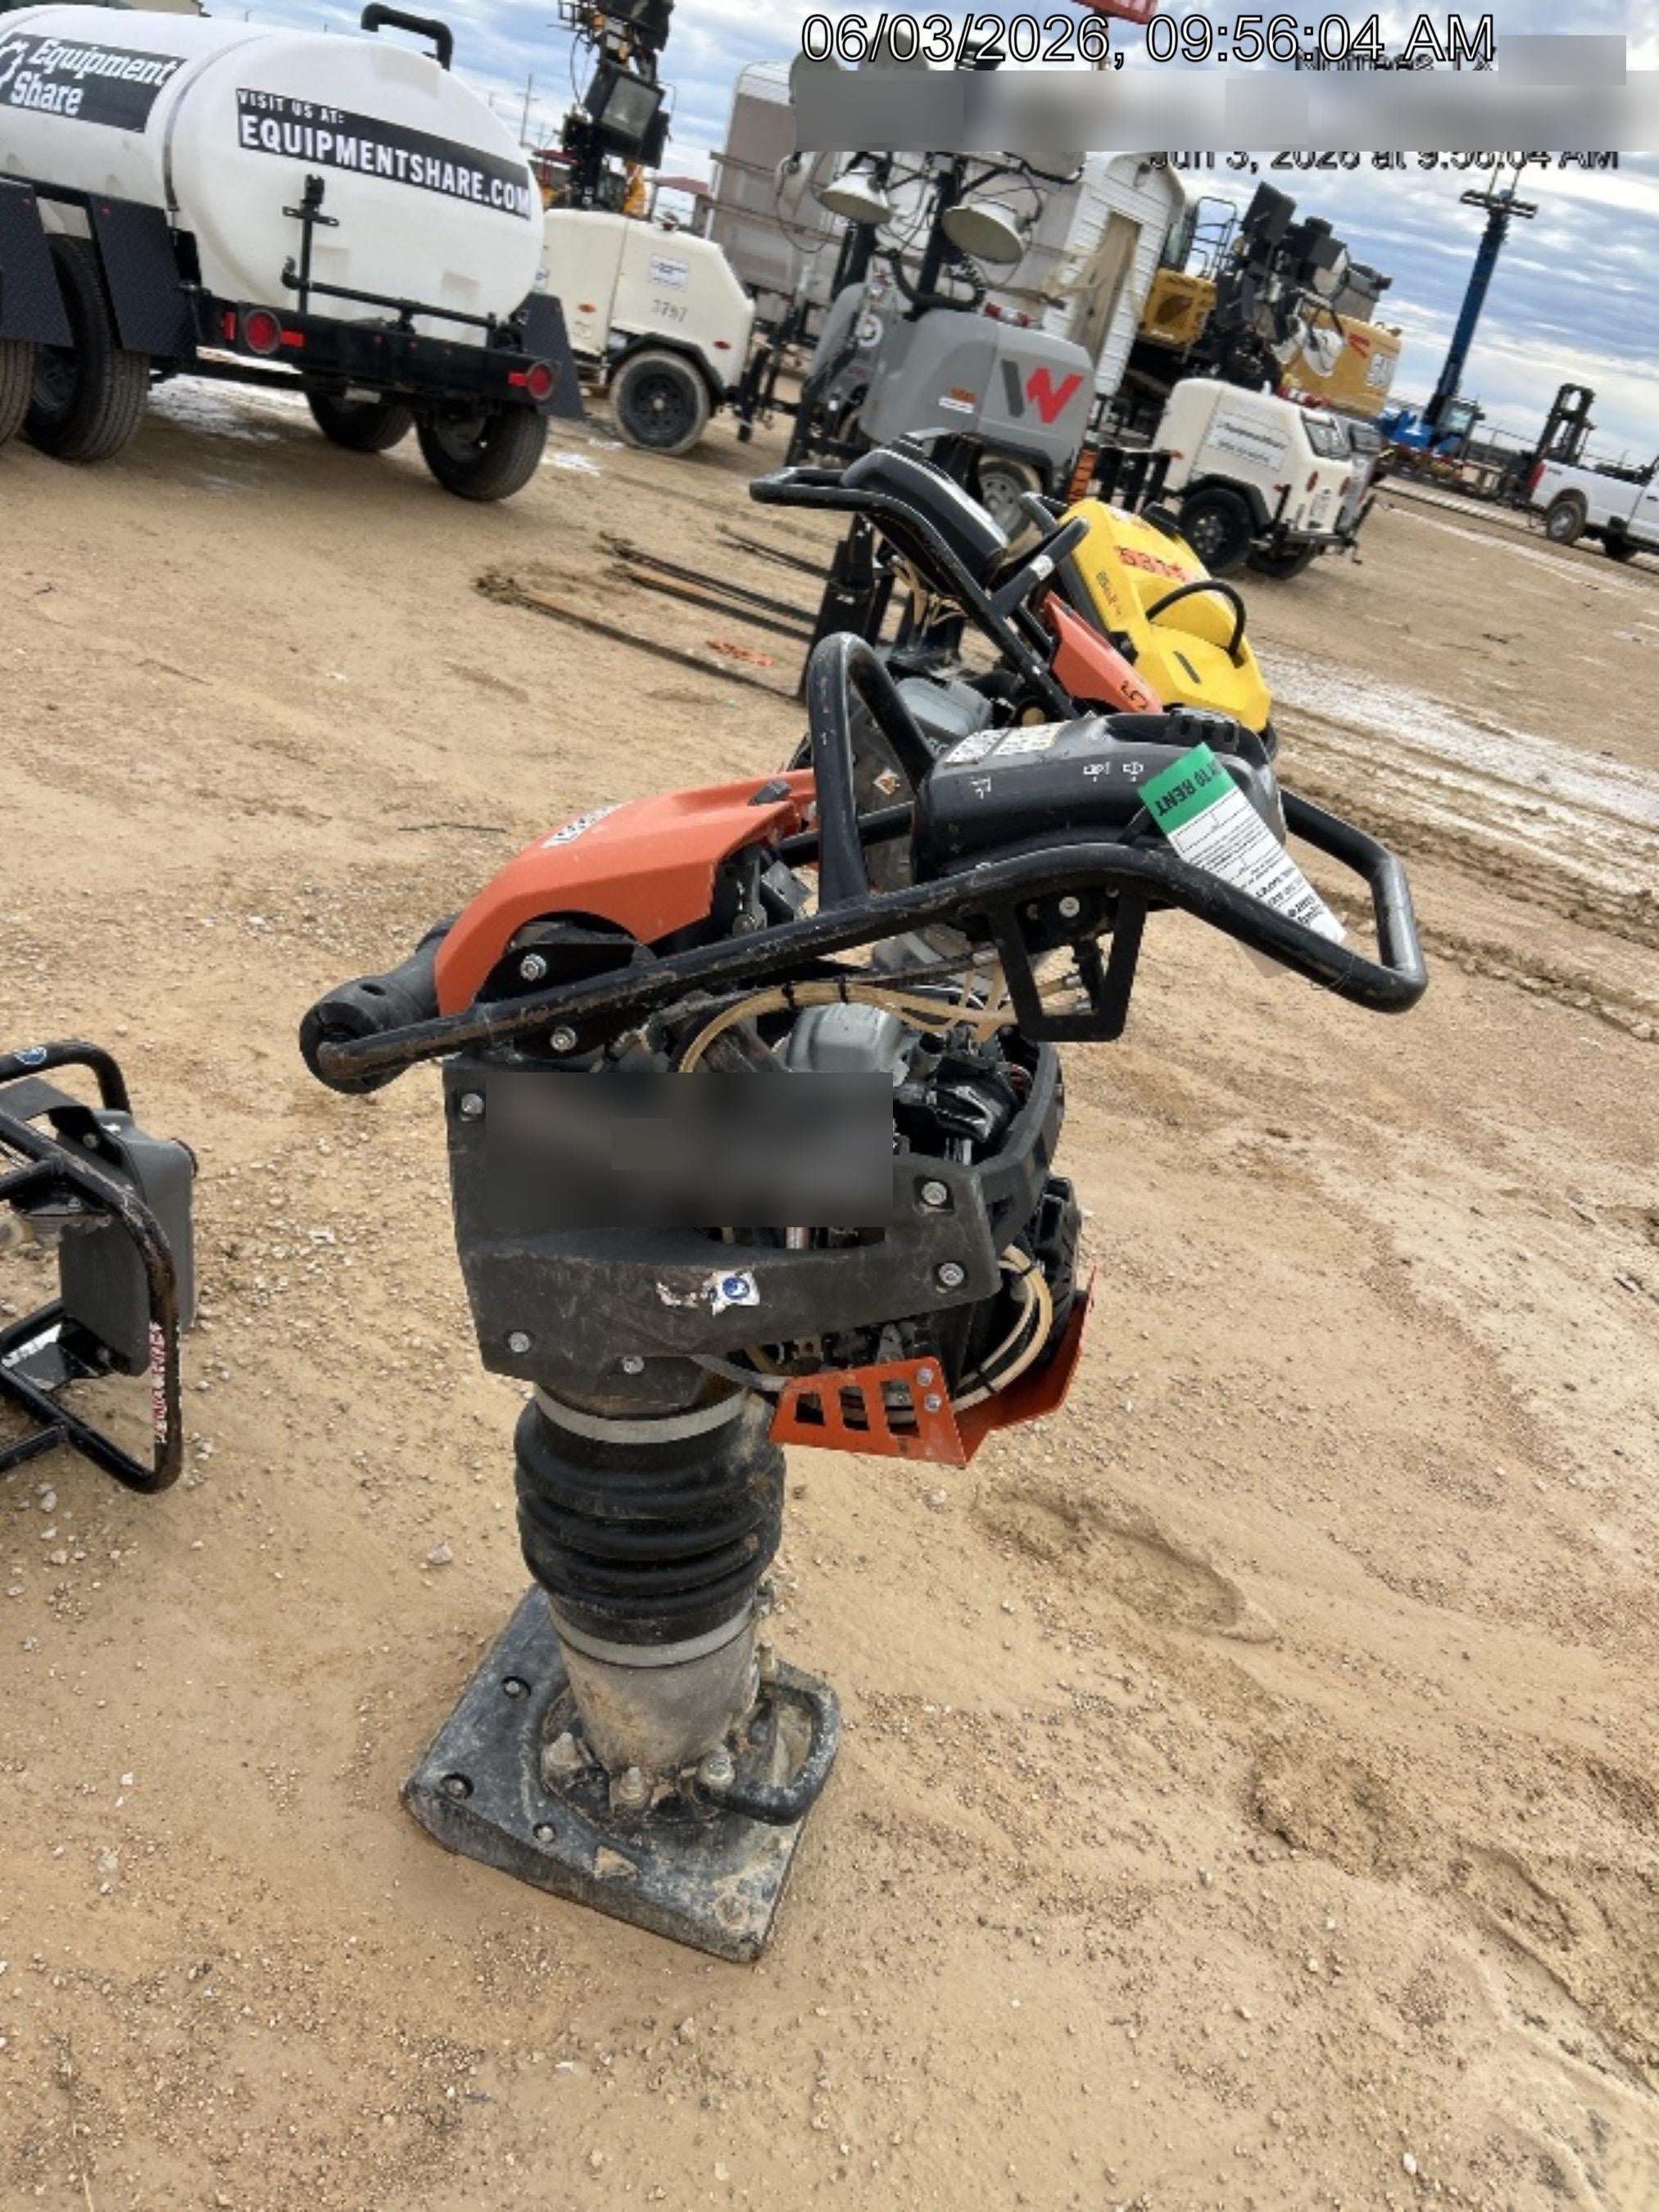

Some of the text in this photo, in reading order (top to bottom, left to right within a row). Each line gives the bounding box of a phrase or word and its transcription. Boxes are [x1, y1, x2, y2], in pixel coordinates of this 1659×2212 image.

[26, 39, 177, 87] Equipment
[10, 70, 83, 117] Share
[238, 90, 345, 124] VISIT US AT:
[240, 113, 531, 213] EQUIPMENTSHARE.COM
[1154, 780, 1196, 817] RENT
